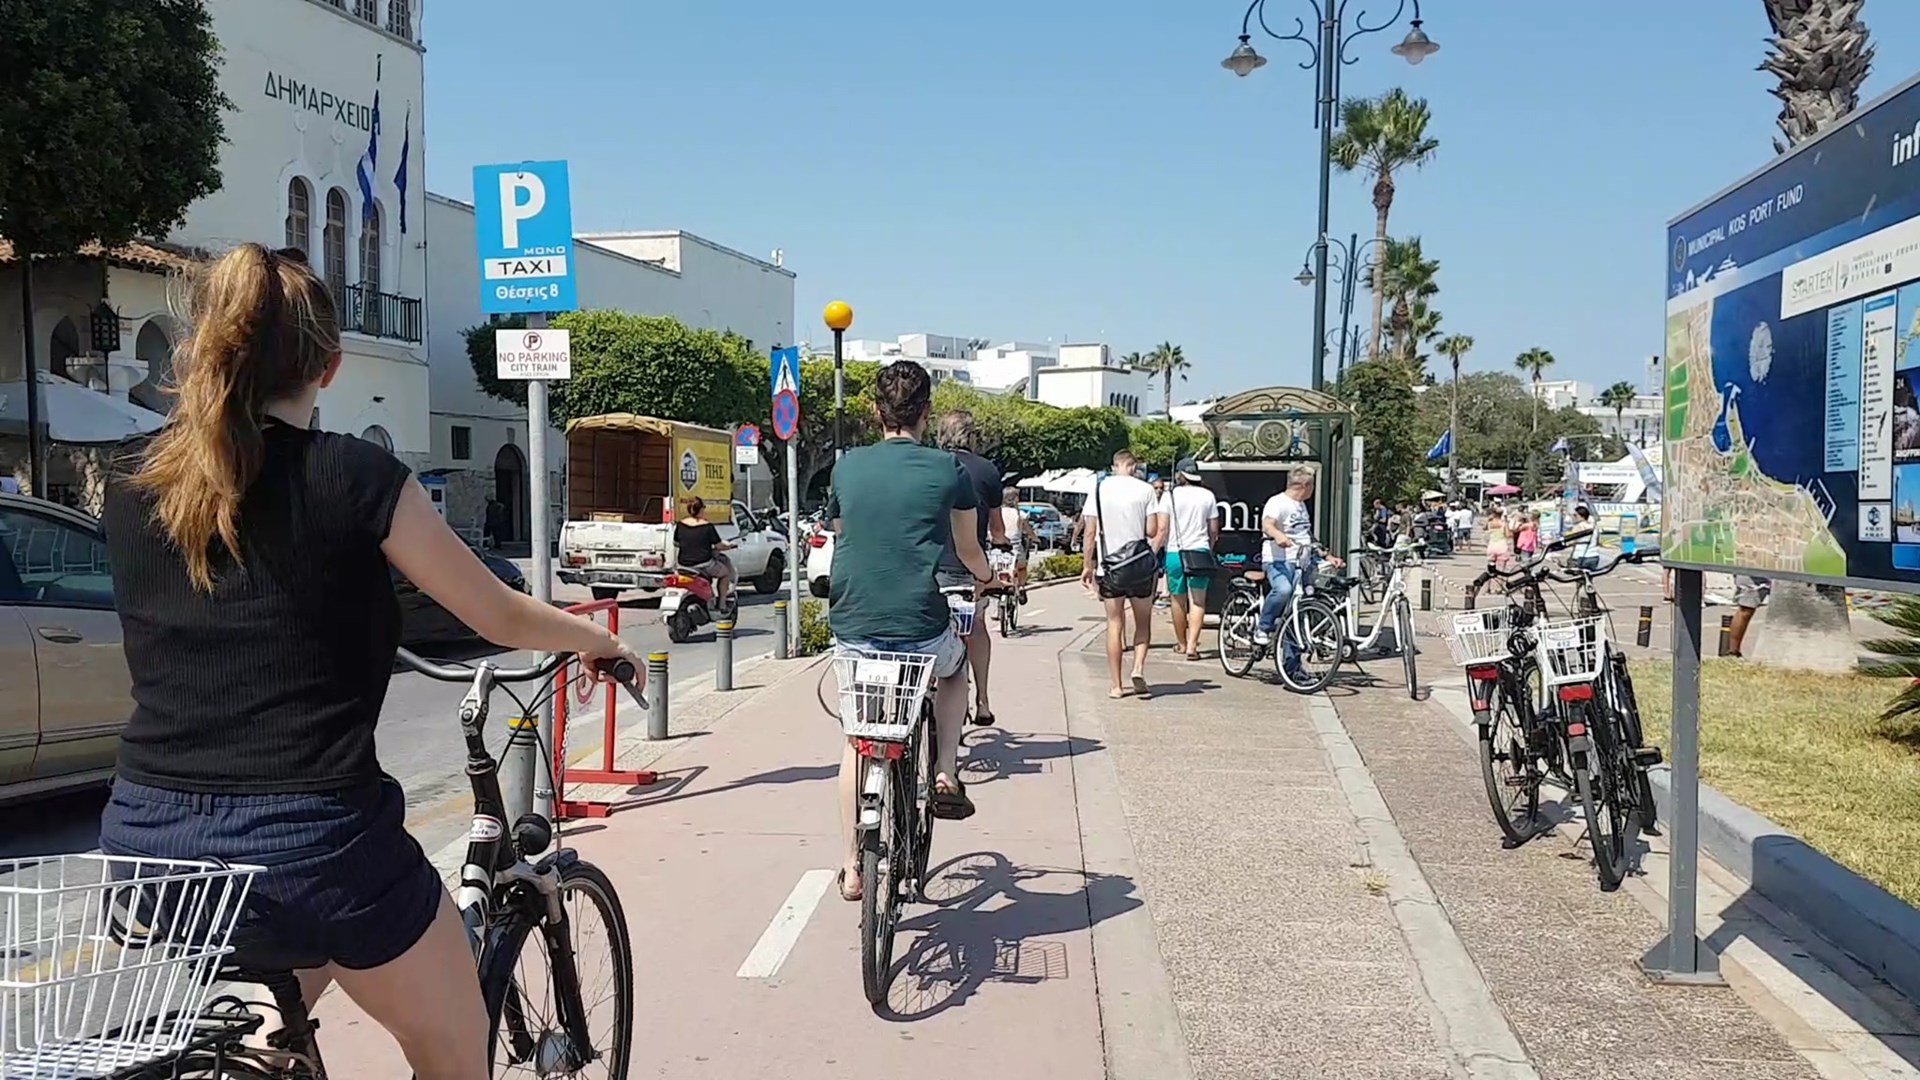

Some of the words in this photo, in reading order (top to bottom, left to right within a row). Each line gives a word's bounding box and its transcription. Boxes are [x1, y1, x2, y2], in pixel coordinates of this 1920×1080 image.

[498, 171, 546, 249] P
[1687, 225, 1726, 258] MUNICIPAL
[1728, 213, 1747, 237] KOS
[1748, 199, 1774, 226] PORT
[1776, 184, 1804, 212] FUND
[498, 258, 552, 276] TAXI
[496, 284, 548, 301] Θέσεις
[549, 283, 559, 298] 8
[499, 352, 516, 363] NO
[518, 351, 568, 363] PARKING
[510, 363, 529, 372] CITY
[531, 363, 557, 372] TRAIN
